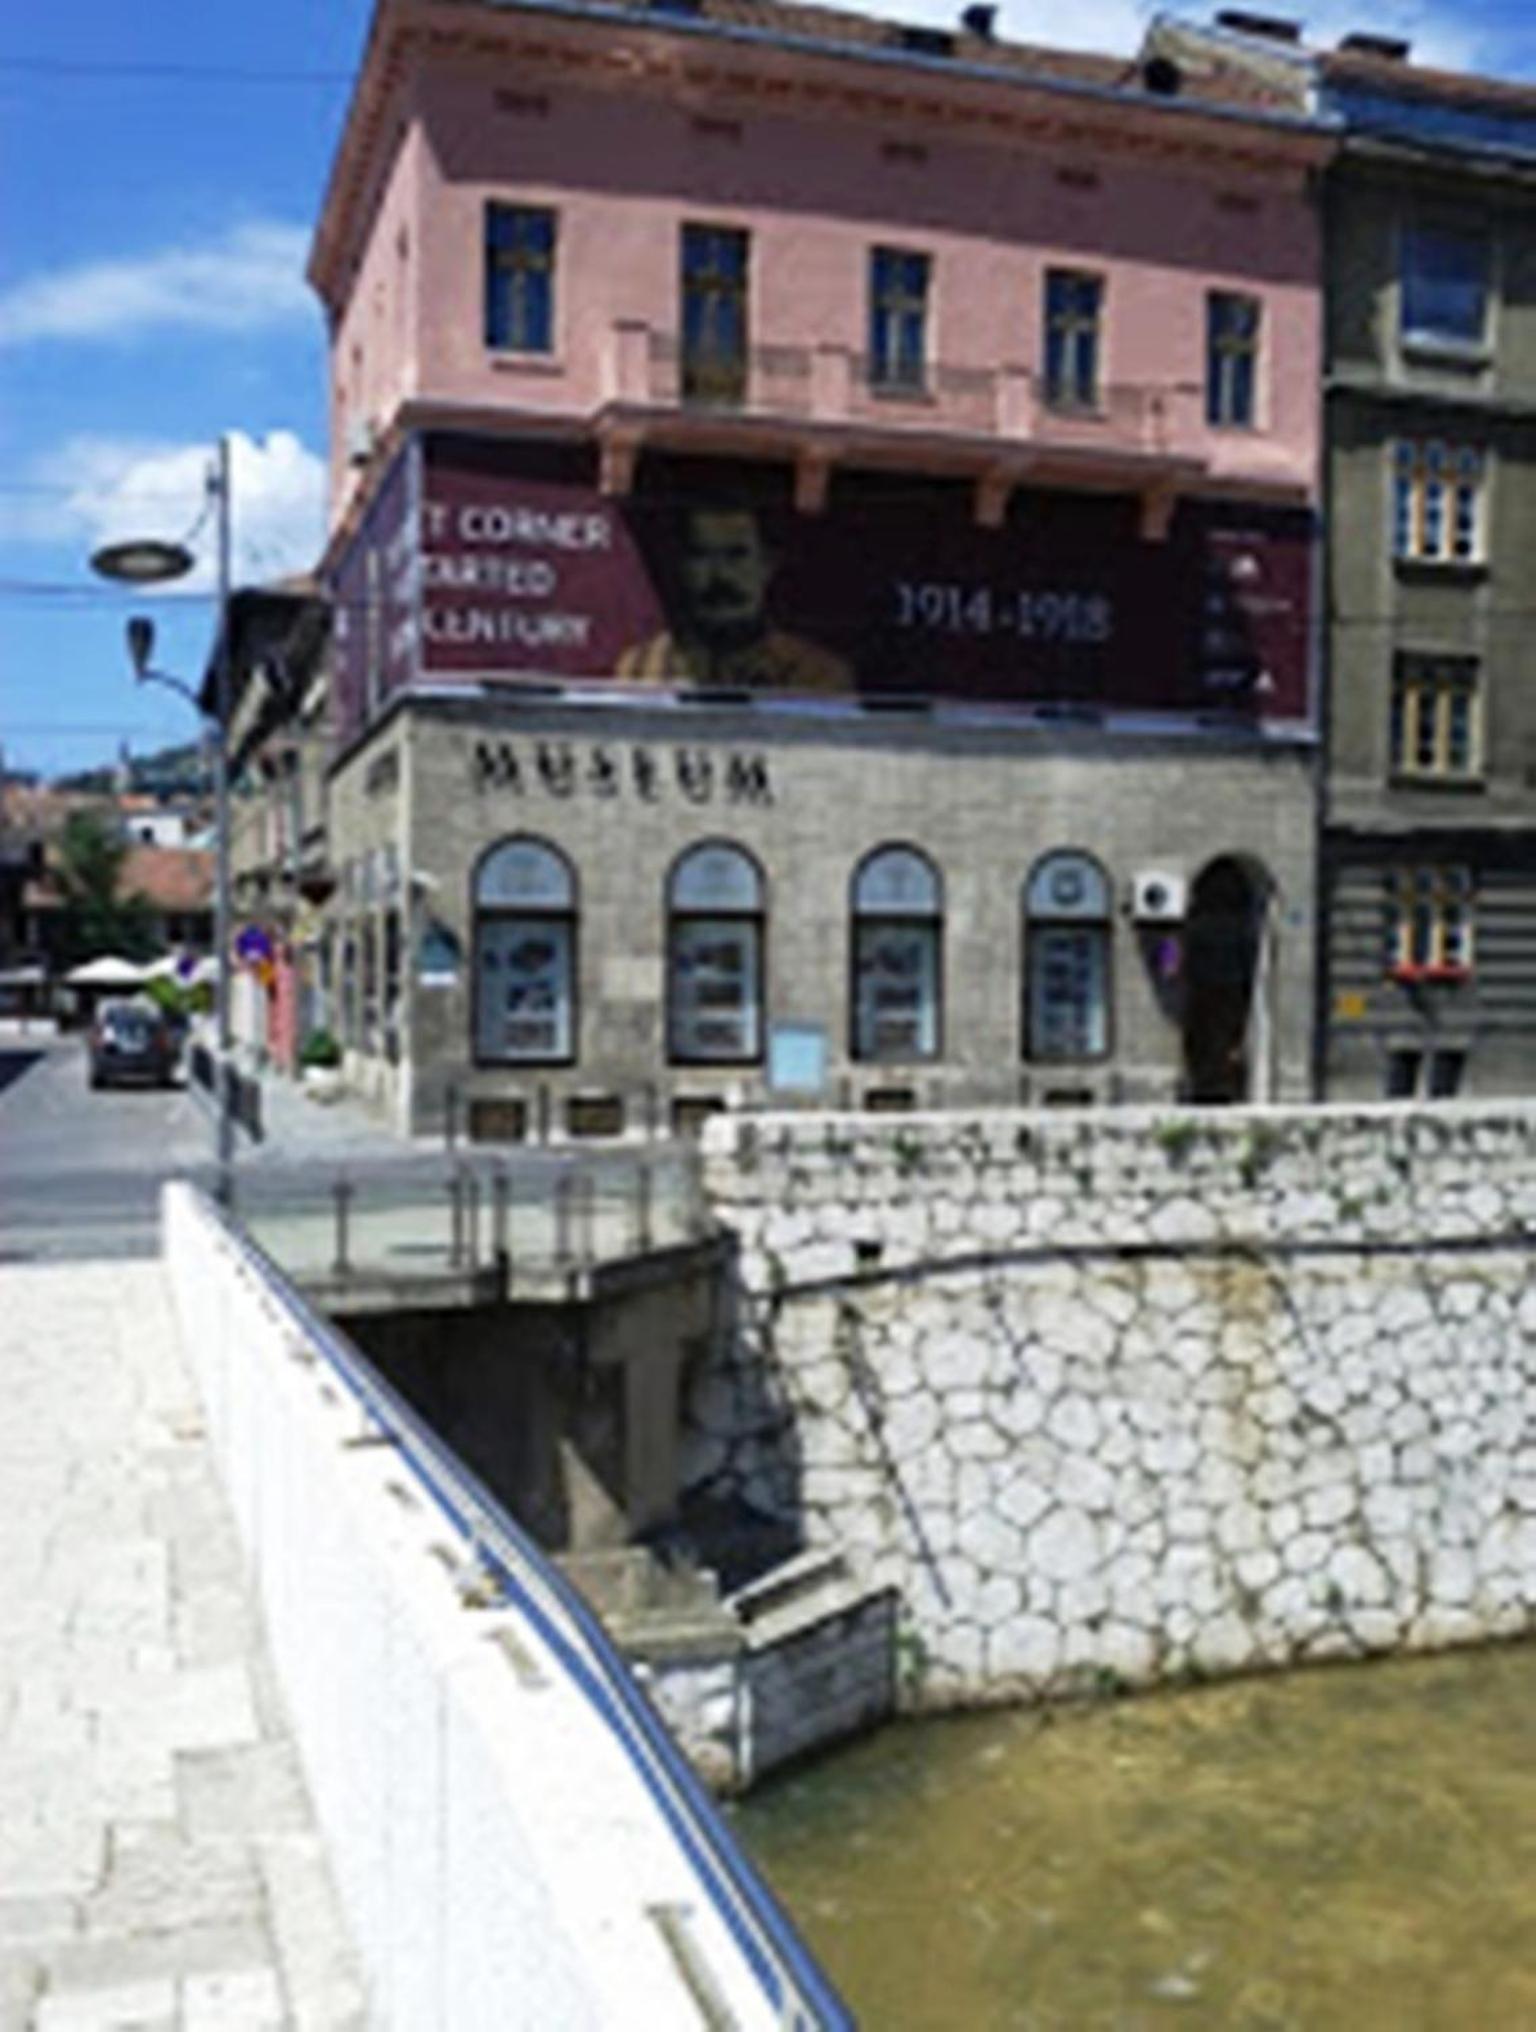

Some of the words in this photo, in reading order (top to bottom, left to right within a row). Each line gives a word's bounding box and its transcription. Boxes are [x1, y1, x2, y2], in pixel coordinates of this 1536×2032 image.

[458, 506, 612, 549] CORNER
[424, 606, 592, 647] CENTURY
[474, 739, 775, 808] MUSEUM
